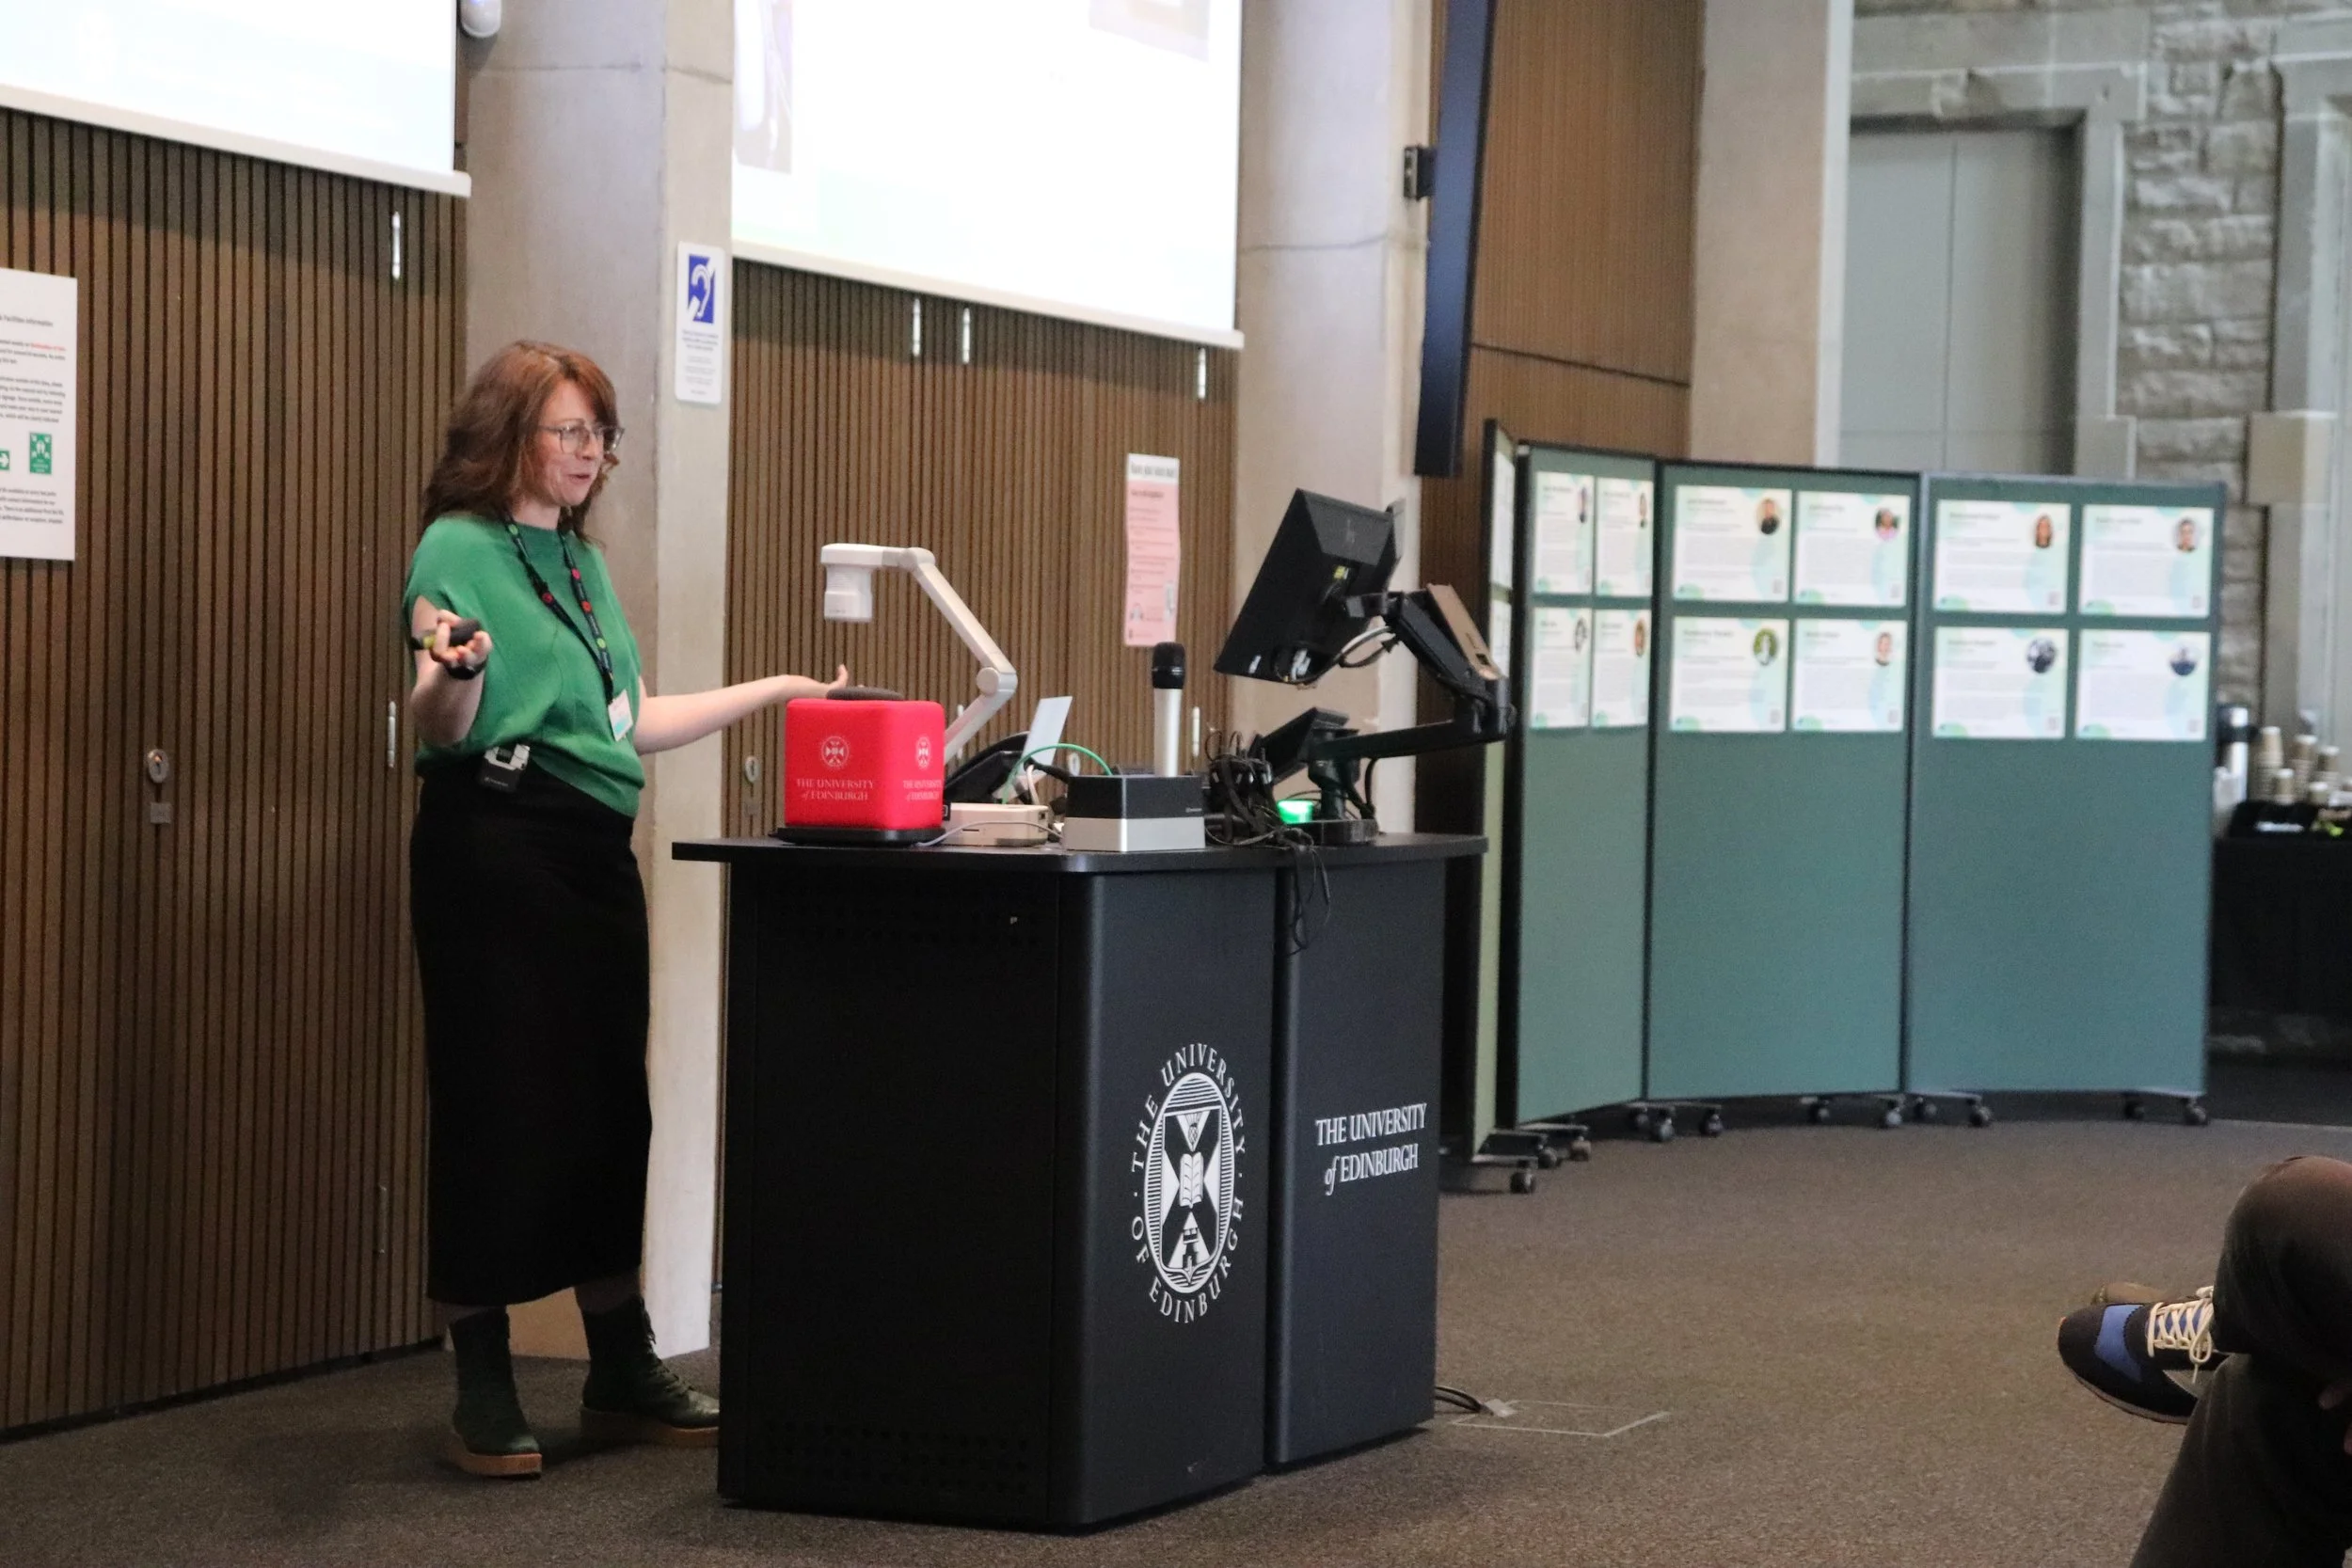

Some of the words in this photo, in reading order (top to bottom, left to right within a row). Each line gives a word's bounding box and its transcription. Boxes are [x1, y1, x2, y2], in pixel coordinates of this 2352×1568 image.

[797, 779, 815, 788] THE
[816, 779, 873, 789] UNIVERSITY
[810, 790, 868, 800] EDINBURGH
[1160, 1042, 1246, 1154] UNIVERSITY
[1131, 1094, 1159, 1173] THE
[1315, 1117, 1347, 1146] THE
[1349, 1102, 1427, 1141] UNIVERSITY
[1324, 1155, 1340, 1196] of
[1340, 1143, 1419, 1183] EDINBURGH
[1132, 1215, 1149, 1263] OF
[1149, 1196, 1244, 1323] EDINBURGH
